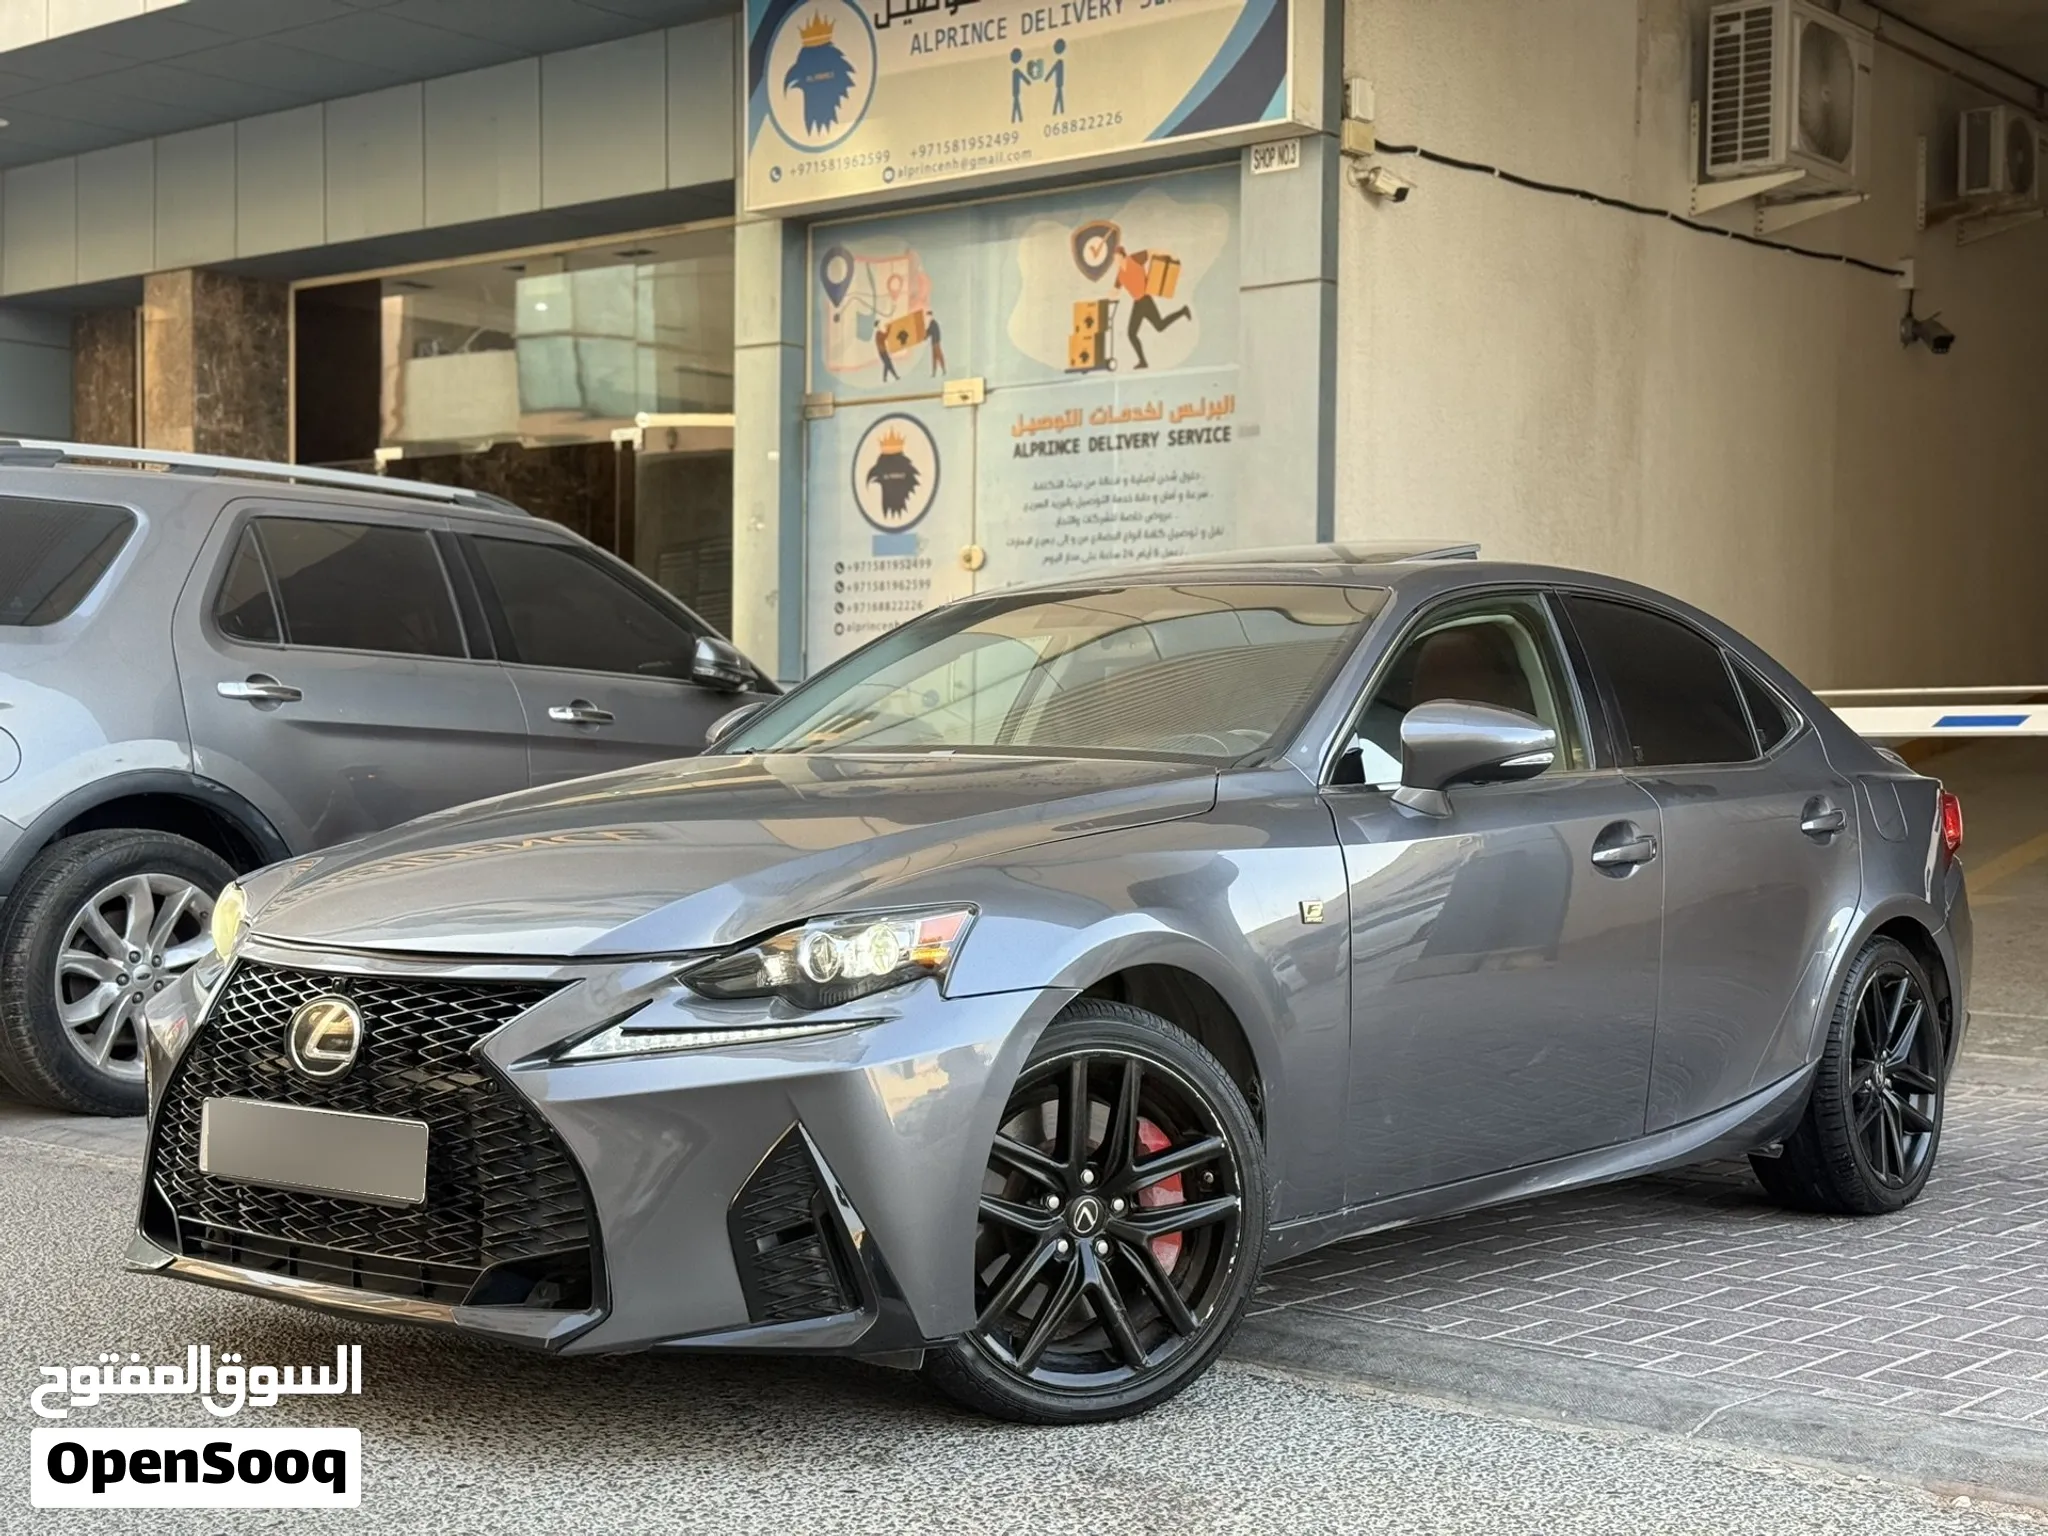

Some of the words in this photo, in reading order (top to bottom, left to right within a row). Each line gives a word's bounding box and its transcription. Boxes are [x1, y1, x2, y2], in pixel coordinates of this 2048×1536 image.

[910, 17, 1008, 56] ALPRINCE
[1043, 111, 1123, 138] 068822226
[911, 131, 1020, 159] +971581952499
[1254, 146, 1275, 170] SHOP
[1011, 408, 1083, 437] التوصيل
[1013, 438, 1080, 459] ALPRINCE
[1088, 431, 1160, 453] DELIVERY
[1168, 425, 1231, 447] SERVICE
